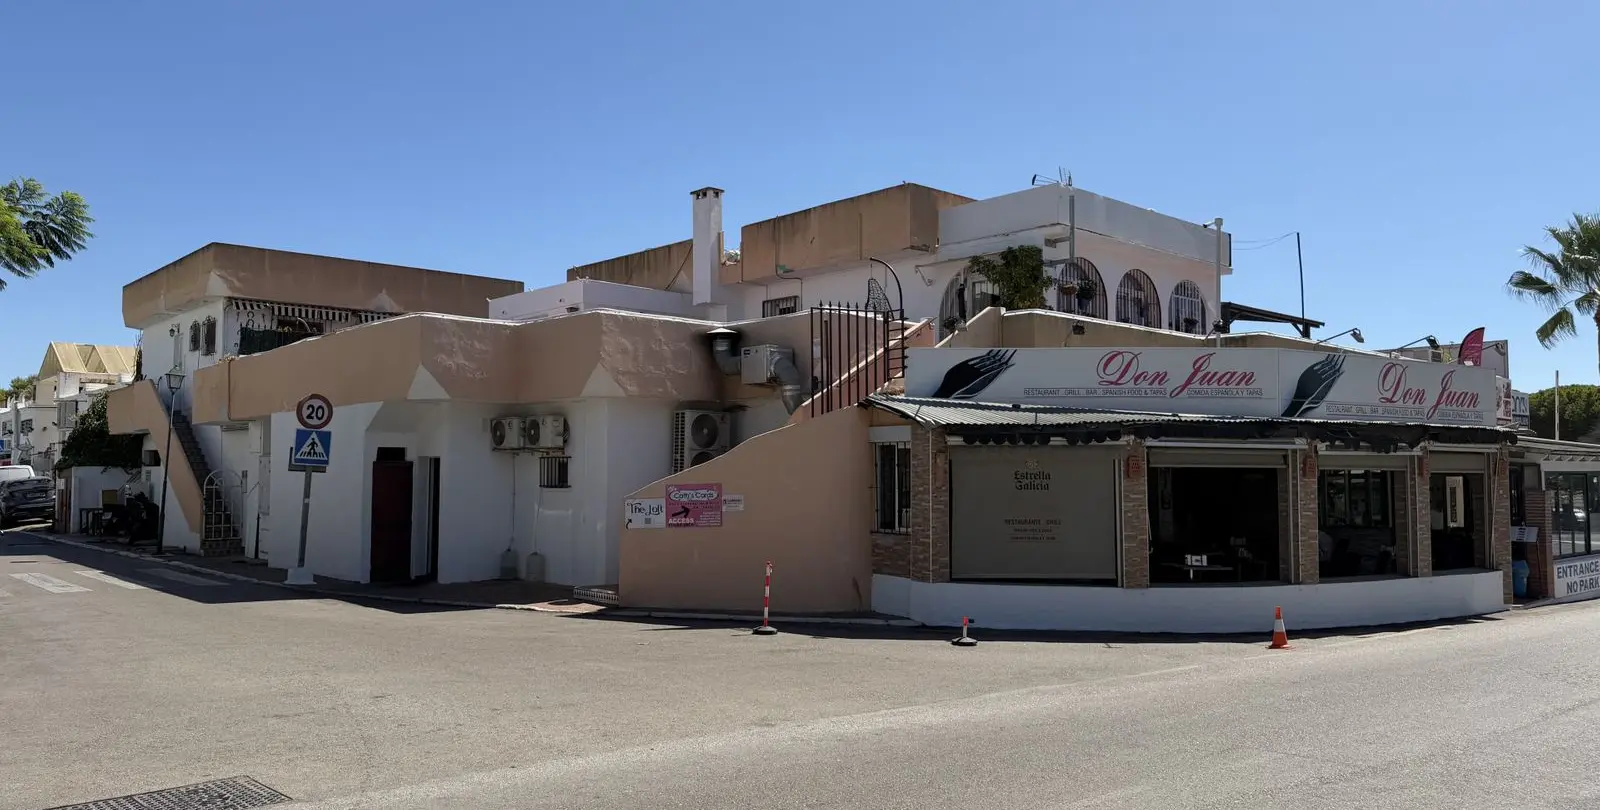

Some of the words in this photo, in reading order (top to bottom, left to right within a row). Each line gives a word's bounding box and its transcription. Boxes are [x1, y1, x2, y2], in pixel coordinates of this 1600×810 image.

[1097, 350, 1169, 386] Don
[1169, 352, 1256, 398] Juan
[1023, 388, 1060, 396] RESTAURANT
[1064, 388, 1081, 396] GRILL
[1150, 388, 1168, 396] TAPAS
[1246, 388, 1264, 396] TAPAS
[1377, 362, 1427, 405] Don
[1426, 369, 1481, 421] Juan
[306, 404, 325, 420] 20
[1014, 471, 1051, 480] Estrella
[1015, 480, 1049, 491] Galicia
[626, 502, 645, 513] The
[644, 504, 663, 516] Loft
[1556, 560, 1599, 579] ENTRANCE
[1566, 580, 1578, 595] NO
